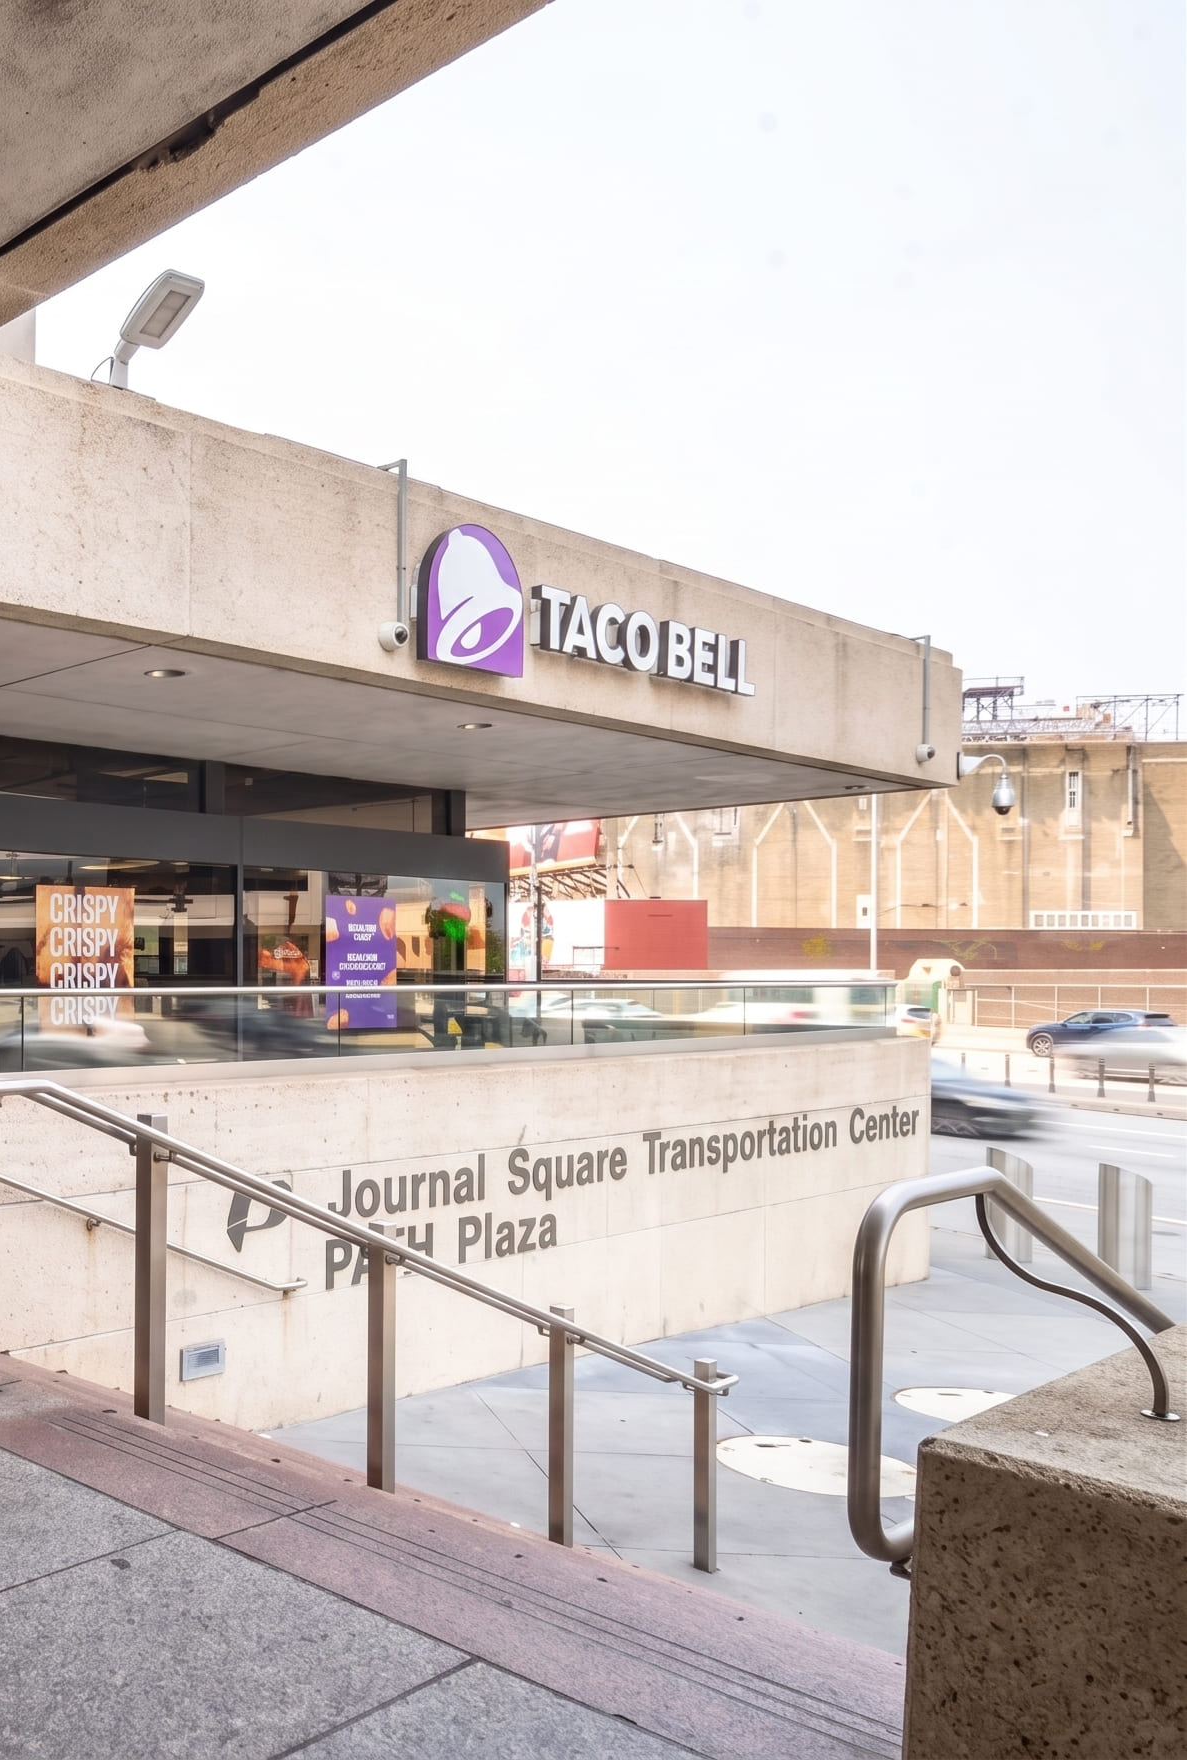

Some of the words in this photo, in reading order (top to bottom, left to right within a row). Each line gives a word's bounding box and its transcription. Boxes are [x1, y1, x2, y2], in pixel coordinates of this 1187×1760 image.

[533, 584, 659, 672] TACO
[662, 620, 756, 696] BELL
[49, 892, 119, 924] CRISPY
[49, 926, 119, 958] CRISPY
[49, 961, 119, 988] CRISPY
[327, 1153, 485, 1218] Journal
[507, 1146, 628, 1201] Square
[642, 1113, 838, 1175] Transportation
[849, 1105, 920, 1144] Center
[325, 1222, 434, 1290] PH
[458, 1212, 557, 1264] Plaza
